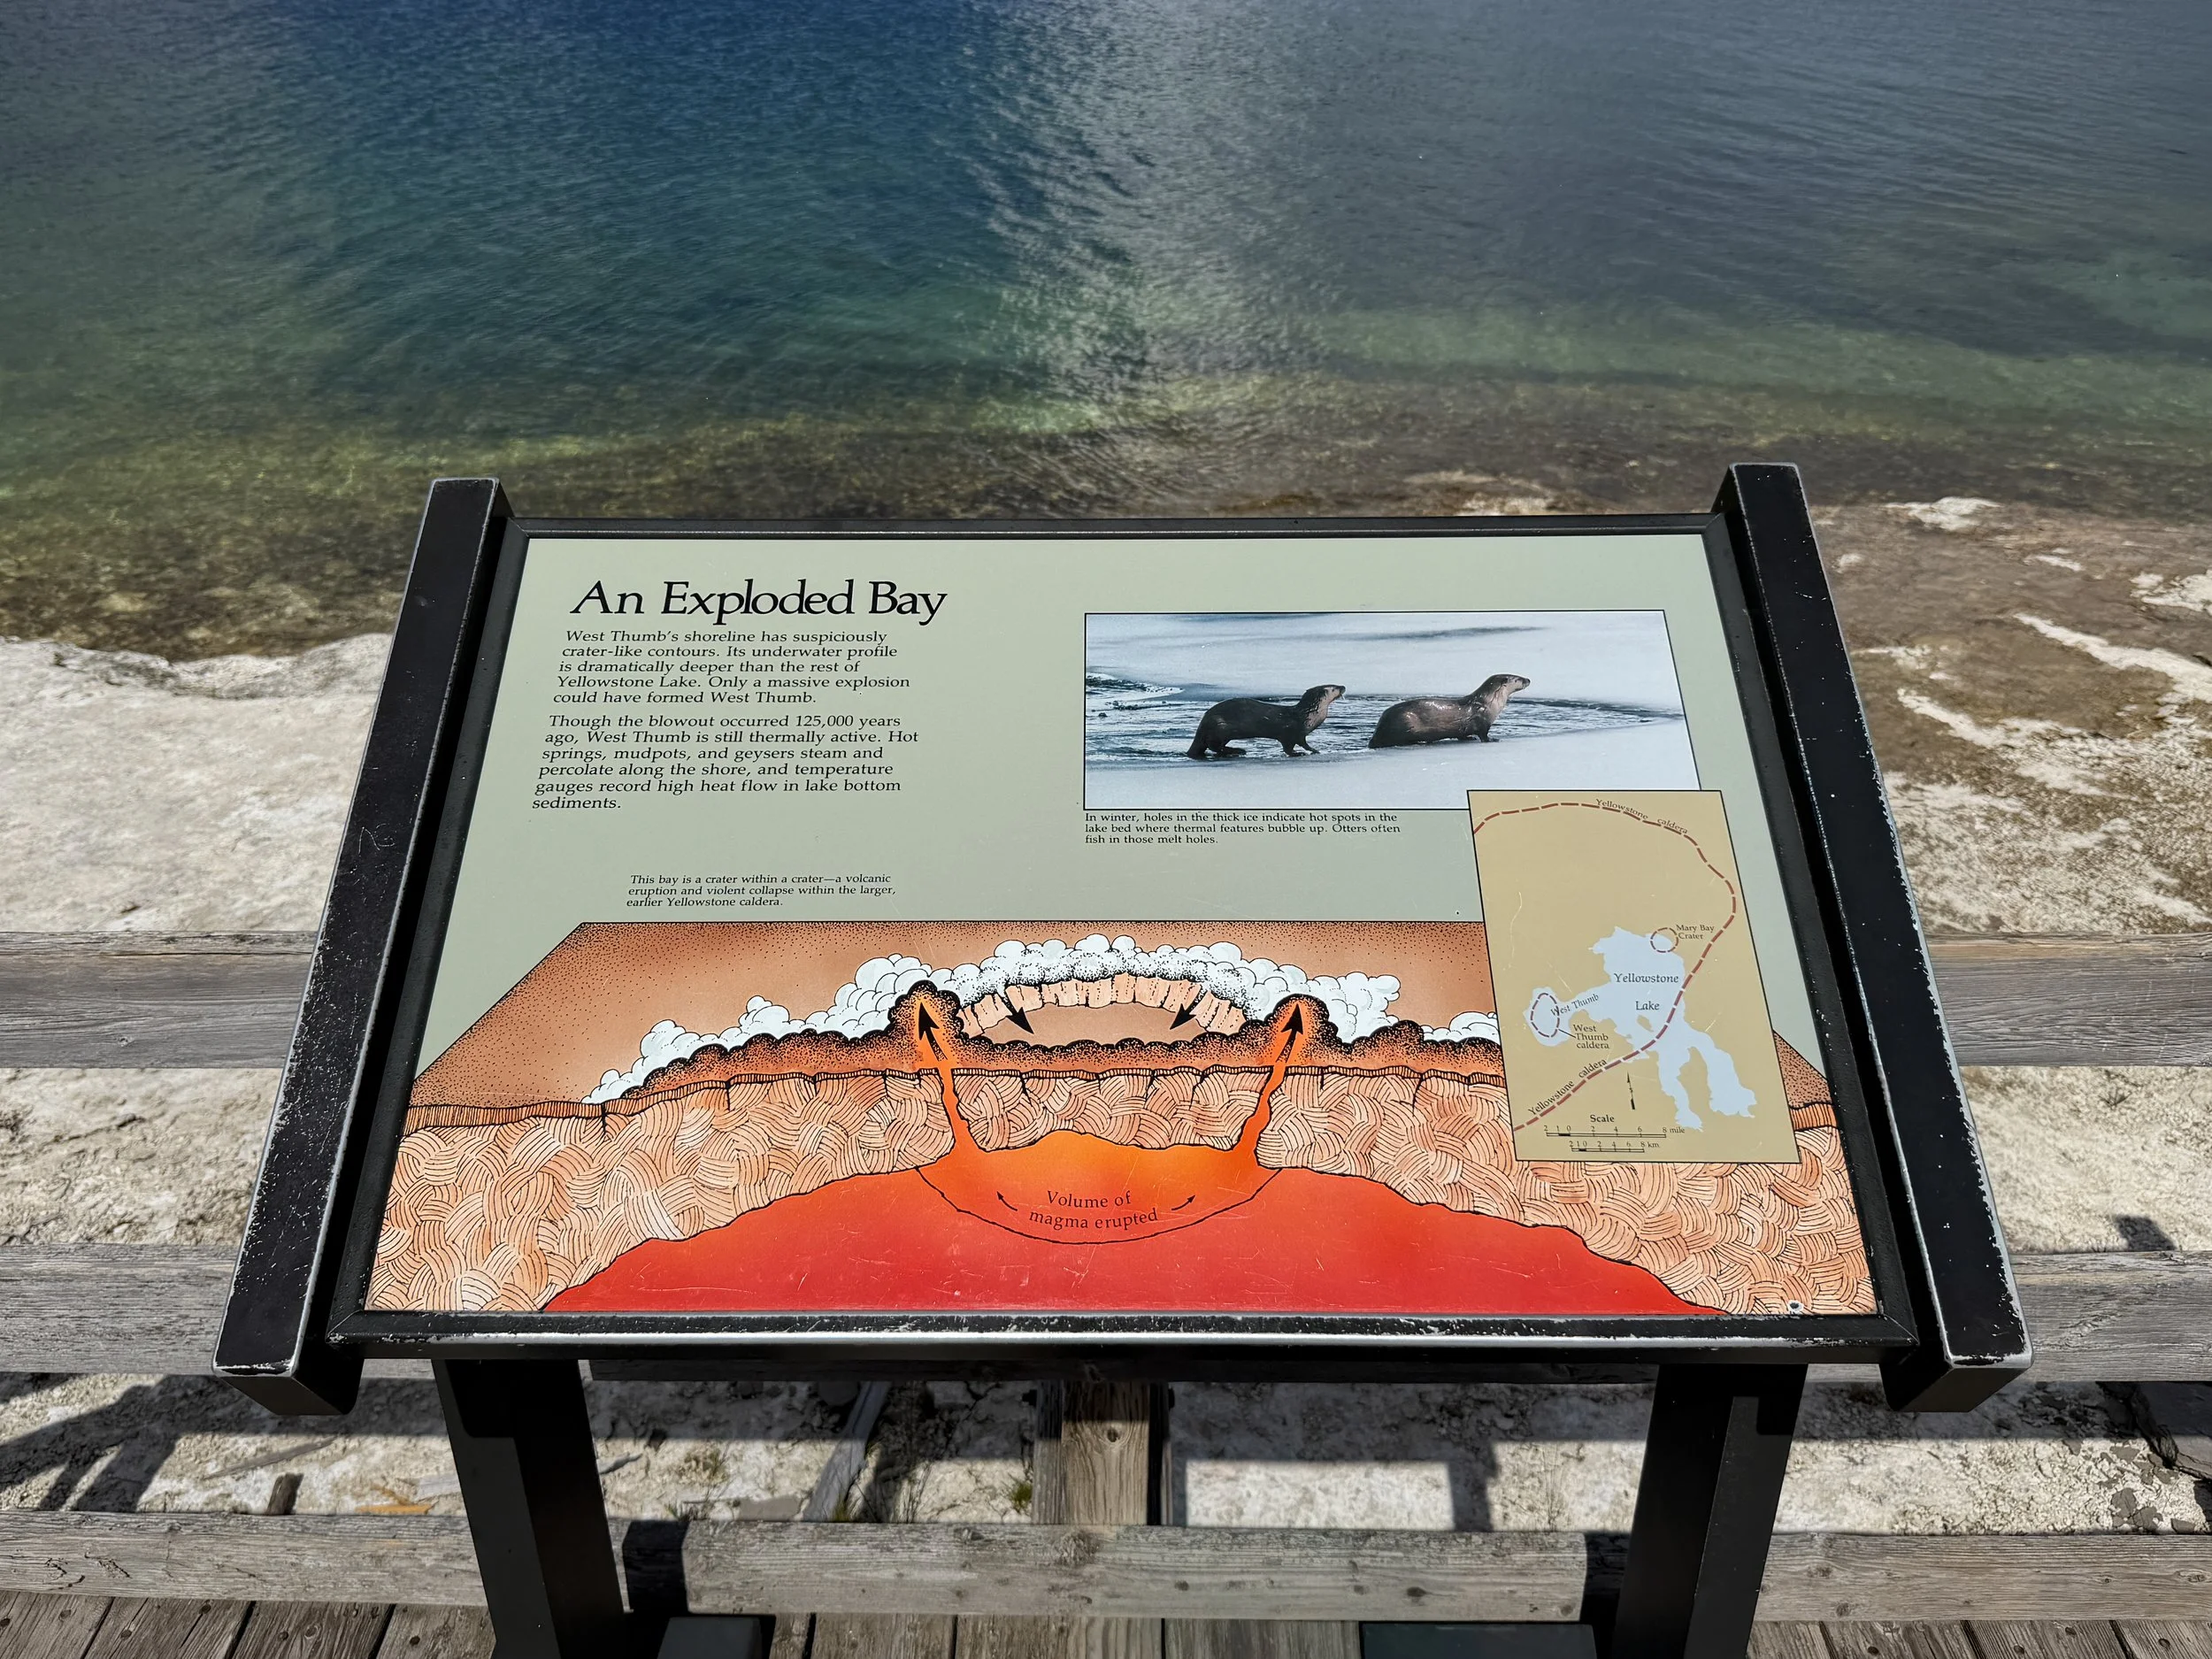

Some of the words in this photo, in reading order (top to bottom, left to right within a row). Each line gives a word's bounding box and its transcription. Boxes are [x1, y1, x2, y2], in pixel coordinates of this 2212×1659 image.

[570, 580, 644, 614] An
[661, 579, 855, 626] Exploded
[869, 581, 948, 626] Bay
[566, 631, 605, 641] West
[611, 631, 678, 641] Thumb's
[684, 631, 756, 641] shoreline
[761, 631, 787, 641] has
[793, 631, 887, 646] suspiciously
[563, 646, 642, 657] crater-like
[648, 647, 719, 657] contours.
[726, 646, 745, 657] Its
[752, 646, 842, 657] underwater
[847, 646, 897, 660] profile
[559, 661, 572, 672] is
[578, 660, 674, 675] dramatically
[680, 661, 734, 676] deeper
[740, 661, 773, 672] than
[780, 661, 804, 672] the
[810, 663, 839, 672] rest
[844, 661, 860, 672] of
[557, 676, 653, 687] Yellowstone
[659, 676, 701, 687] Lake.
[709, 676, 748, 691] Only
[767, 676, 830, 687] massive
[835, 676, 910, 691] explosion
[554, 691, 597, 703] could
[603, 691, 641, 703] have
[646, 691, 703, 703] formed
[710, 692, 749, 703] West
[756, 692, 816, 703] Thumb.
[549, 715, 611, 731] Though
[618, 715, 642, 726] the
[649, 715, 715, 726] blowout
[720, 715, 788, 726] occurred
[796, 715, 853, 728] 125,000
[858, 718, 900, 730] years
[545, 734, 579, 747] ago,
[588, 731, 627, 742] West
[633, 731, 690, 742] Thumb
[695, 731, 708, 742] is
[715, 731, 743, 742] still
[749, 731, 826, 746] thermally
[831, 731, 880, 742] active.
[888, 731, 918, 741] Hot
[542, 748, 606, 763] springs,
[614, 747, 690, 763] mudpots,
[698, 747, 728, 758] and
[734, 750, 795, 763] geysers
[801, 749, 847, 758] steam
[853, 747, 883, 758] and
[538, 764, 613, 779] percolate
[619, 764, 664, 779] along
[671, 763, 695, 775] the
[702, 763, 750, 777] shore,
[757, 763, 787, 775] and
[795, 764, 893, 779] temperature
[534, 783, 593, 795] gauges
[598, 780, 651, 792] record
[657, 780, 693, 795] high
[700, 780, 736, 791] heat
[741, 780, 778, 791] flow
[783, 780, 798, 791] in
[805, 780, 838, 791] lake
[844, 780, 901, 791] bottom
[533, 796, 620, 809] sediments.
[1101, 813, 1139, 823] winter,
[1144, 812, 1172, 821] holes
[1191, 812, 1209, 821] the
[1213, 812, 1240, 821] thick
[1262, 812, 1305, 821] indicate
[1310, 812, 1327, 821] hot
[1332, 814, 1361, 824] spots
[1380, 812, 1397, 821] the
[1595, 798, 1648, 819] Yellowstone
[1657, 818, 1688, 833] caldera
[1135, 824, 1170, 833] where
[1221, 824, 1263, 833] features
[1310, 826, 1327, 835] up.
[1333, 823, 1367, 833] Otters
[1371, 824, 1400, 833] often
[1086, 834, 1105, 843] fish
[1157, 834, 1182, 843] melt
[631, 875, 655, 884] This
[659, 875, 679, 886] bay
[741, 874, 777, 883] within
[846, 874, 890, 883] volcanic
[628, 887, 676, 897] eruption
[681, 886, 703, 895] and
[707, 886, 745, 895] violent
[749, 886, 794, 897] collapse
[860, 886, 895, 896] larger,
[626, 897, 663, 906] earlier
[667, 897, 735, 906] Yellowstone
[740, 897, 782, 906] caldera.
[1614, 973, 1678, 983] Yellowstone
[1571, 994, 1599, 1010] Thumb
[1635, 1001, 1660, 1010] Lake
[1528, 1080, 1575, 1115] Yellowstone
[1578, 1059, 1607, 1078] caldera
[1048, 1190, 1108, 1208] Volume
[1114, 1190, 1131, 1206] of
[1029, 1211, 1088, 1230] magma
[1095, 1208, 1158, 1230] erupted
